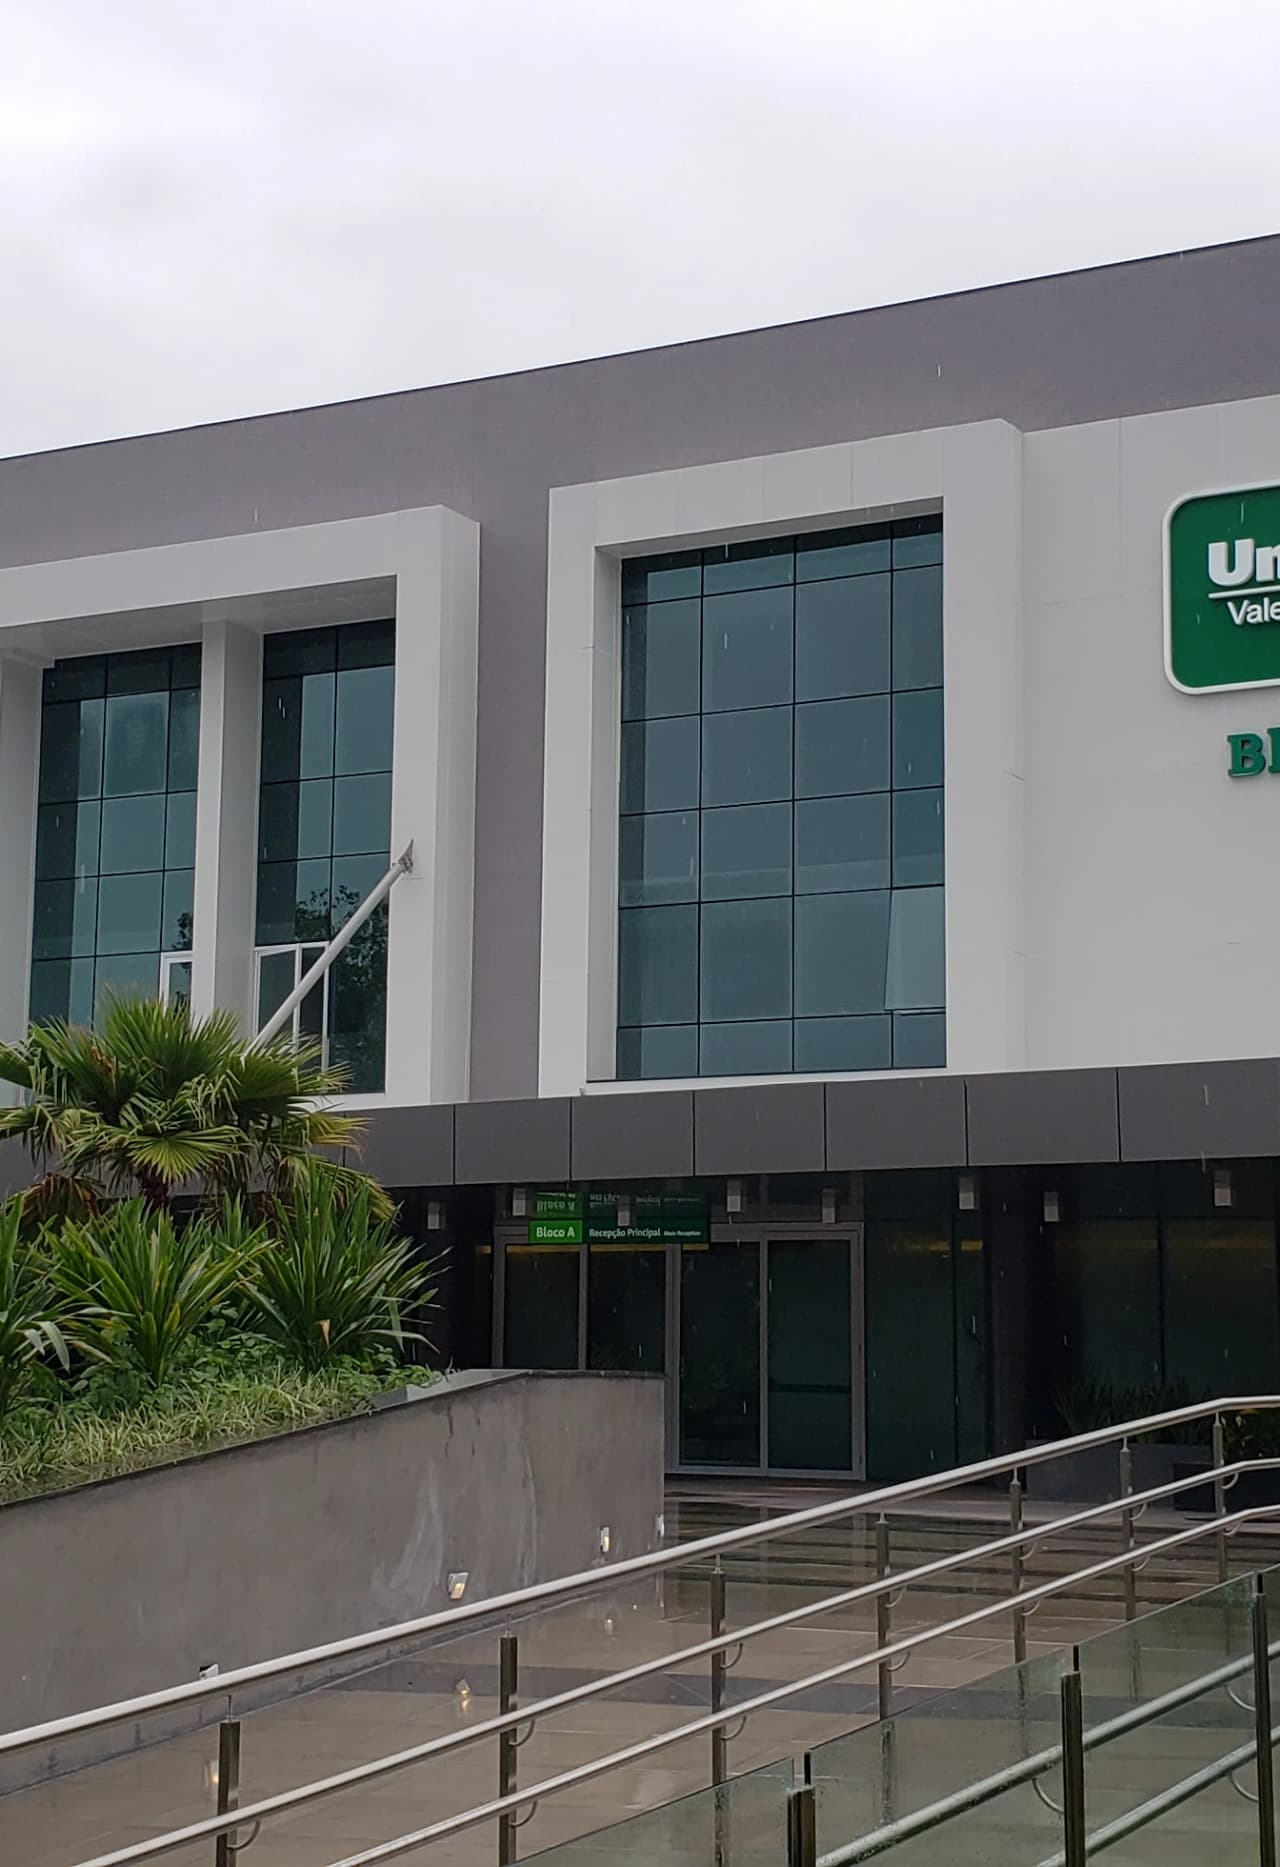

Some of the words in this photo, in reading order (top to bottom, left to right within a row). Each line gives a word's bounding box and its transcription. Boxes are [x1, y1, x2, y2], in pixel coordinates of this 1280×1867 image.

[536, 1226, 565, 1238] Bloco
[567, 1226, 575, 1238] A
[589, 1228, 626, 1239] Recepção
[627, 1227, 661, 1239] Principal
